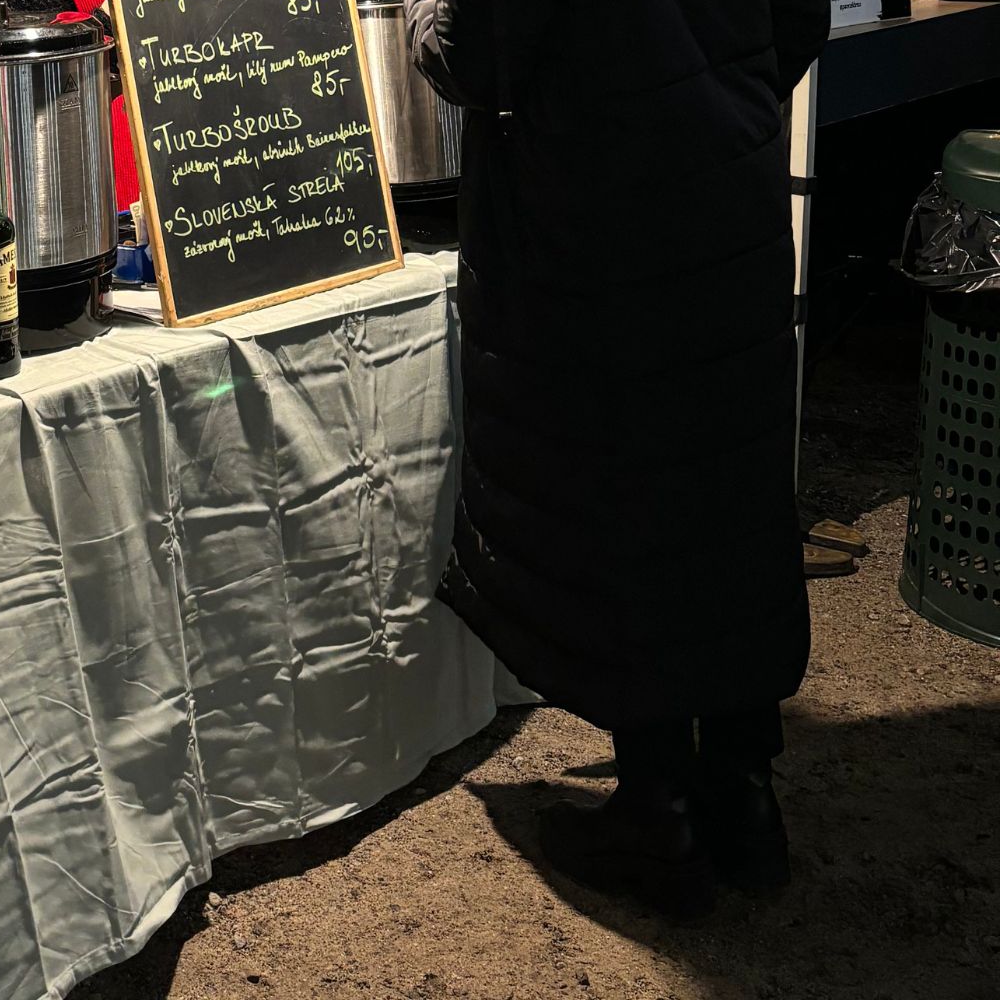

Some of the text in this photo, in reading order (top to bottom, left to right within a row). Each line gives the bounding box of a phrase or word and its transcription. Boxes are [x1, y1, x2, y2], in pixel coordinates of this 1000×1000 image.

[140, 30, 275, 71] TURBOKAPR
[152, 66, 204, 105] jablkový
[246, 57, 267, 86] bílý
[269, 54, 295, 74] rum
[297, 43, 353, 70] Pampero
[152, 104, 303, 155] TURBOŠROUB
[171, 155, 221, 186] jablkový
[173, 173, 346, 237] SLOVENSKÁ STRELA
